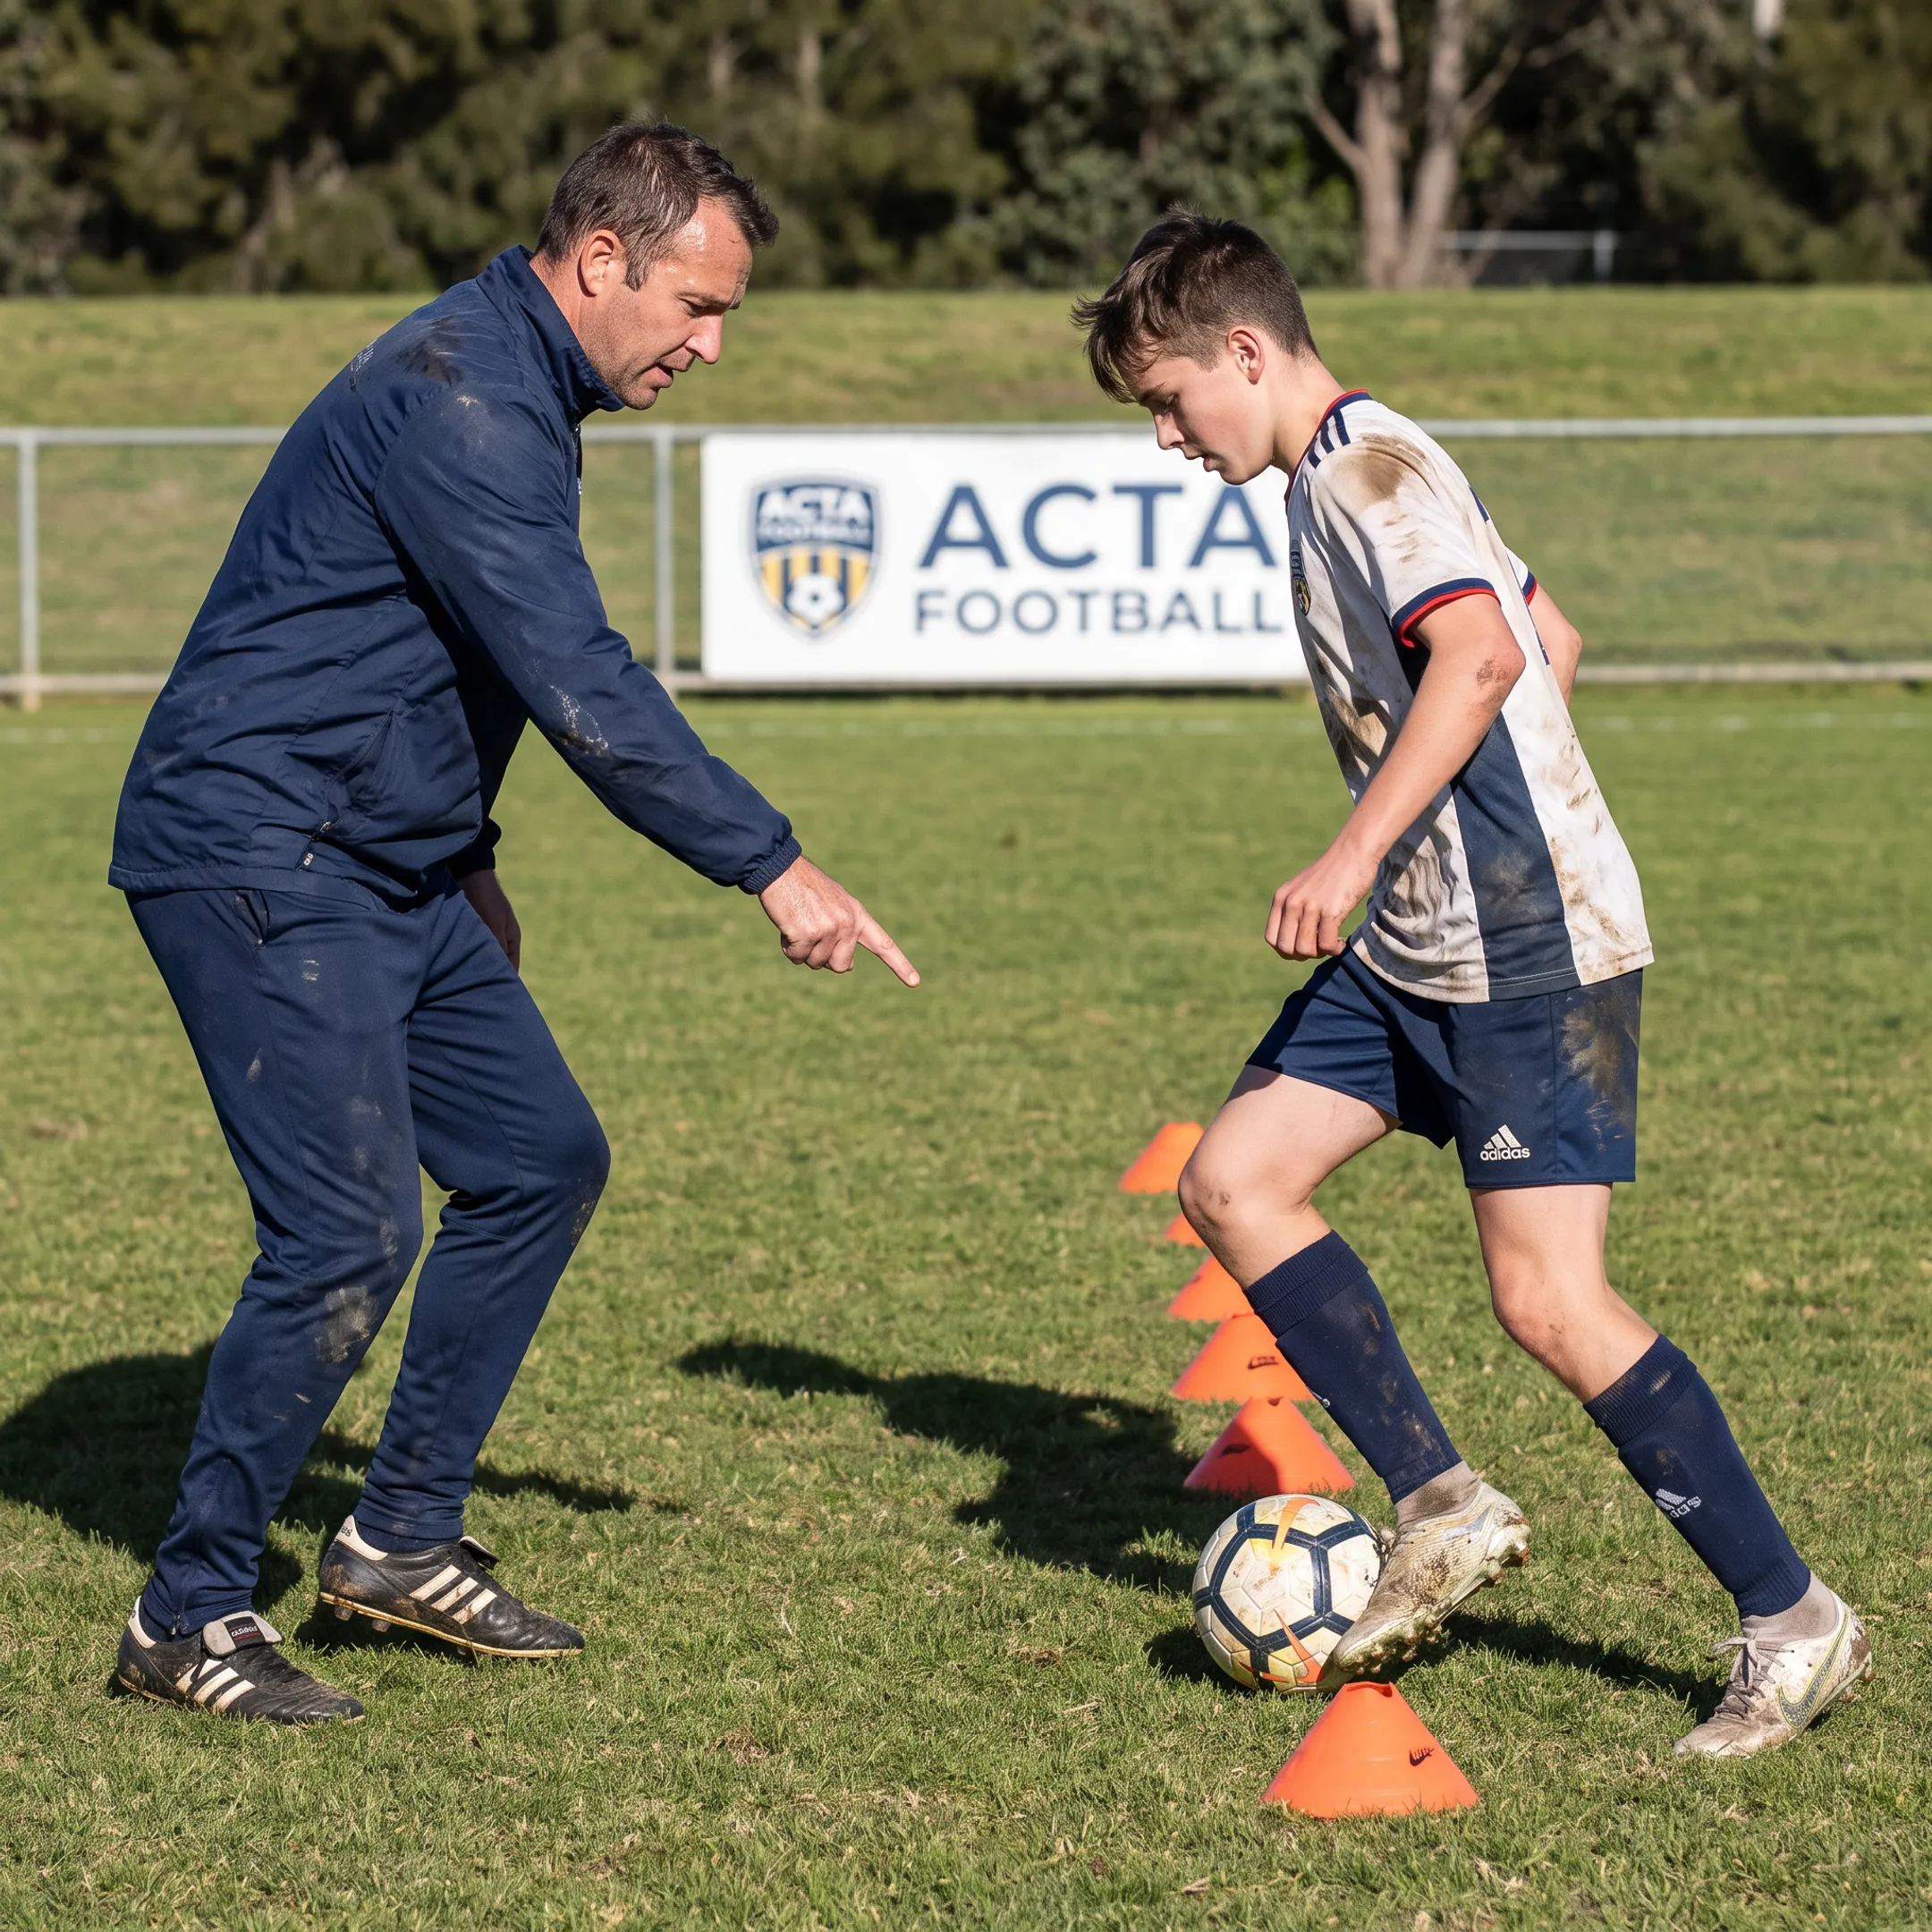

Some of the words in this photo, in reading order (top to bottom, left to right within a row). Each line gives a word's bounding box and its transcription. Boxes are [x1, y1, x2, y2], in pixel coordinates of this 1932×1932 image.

[758, 487, 870, 522] ACTA
[919, 485, 1277, 569] ACTA
[915, 589, 1283, 633] FOOTBALL
[1480, 1147, 1530, 1161] adidas
